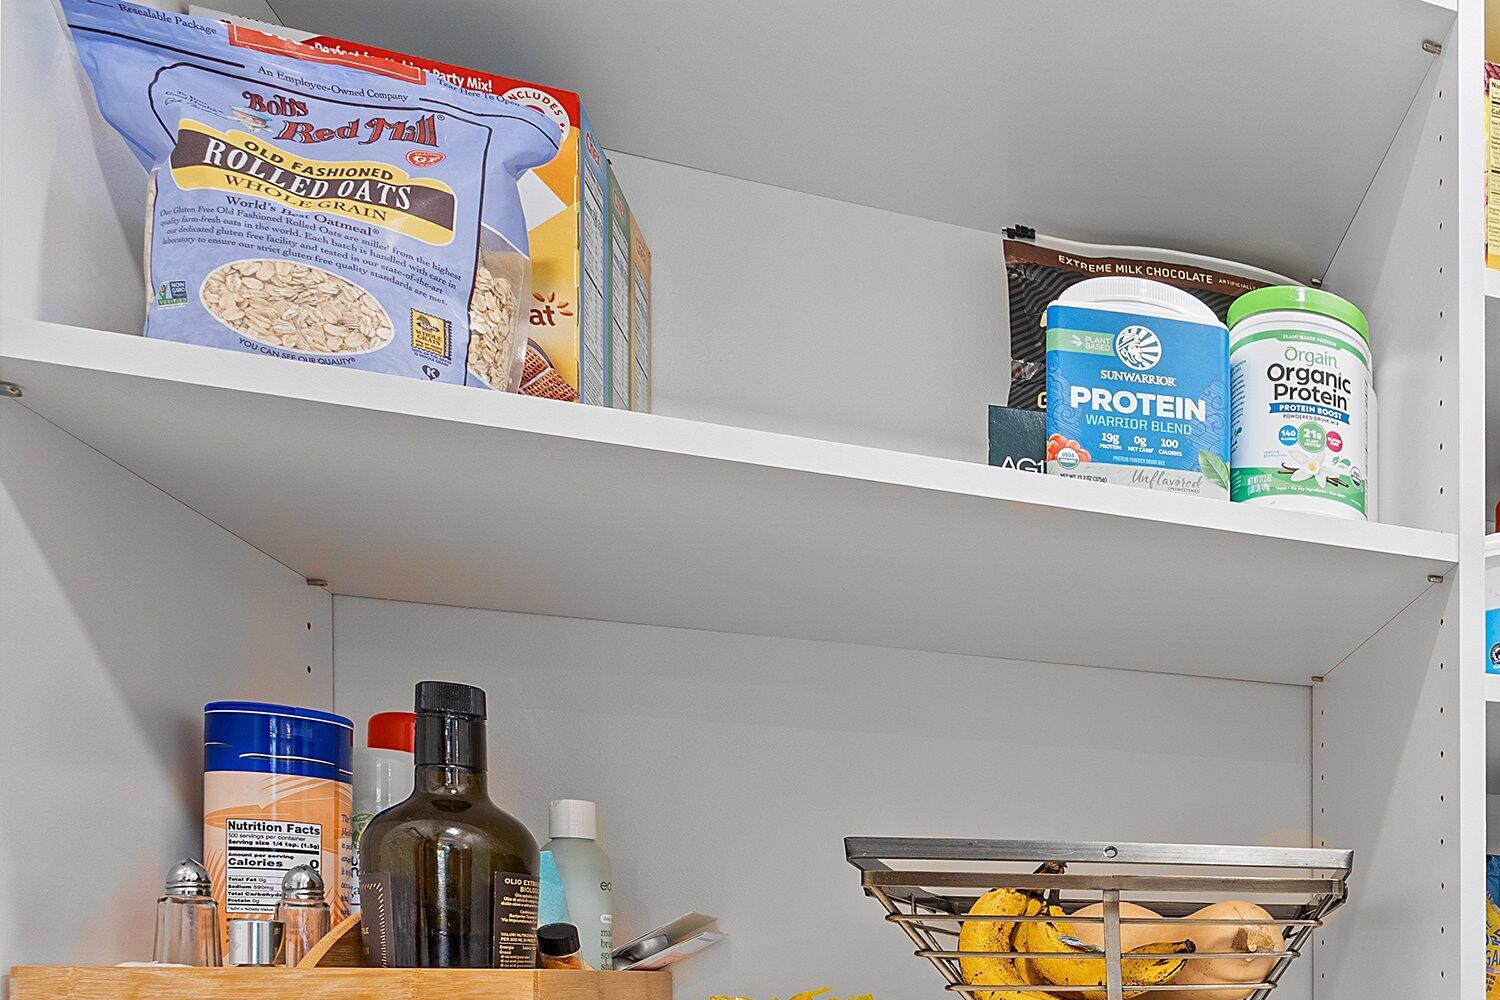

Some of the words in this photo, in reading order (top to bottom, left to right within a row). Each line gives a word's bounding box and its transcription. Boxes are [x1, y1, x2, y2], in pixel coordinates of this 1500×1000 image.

[119, 4, 172, 23] Resealable
[175, 17, 217, 34] Package
[258, 66, 273, 77] An
[277, 71, 364, 97] Employee-Owned
[367, 89, 408, 102] Company
[273, 118, 360, 144] Red
[358, 114, 439, 148] Mill
[203, 137, 329, 199] ROLLED
[338, 179, 411, 210] OATS
[244, 141, 284, 163] OLD
[292, 162, 393, 180] FASHIONED
[224, 174, 312, 210] WHOLE
[318, 200, 387, 221] GRAIN
[226, 196, 276, 212] World's
[237, 210, 282, 224] Fashioned
[216, 227, 244, 237] gluten
[246, 231, 264, 240] free
[266, 235, 298, 247] facility
[300, 243, 317, 251] and
[320, 247, 348, 259] tested
[362, 258, 378, 267] our
[305, 233, 329, 244] Each
[332, 238, 357, 252] batch
[370, 249, 406, 267] handled
[408, 263, 428, 276] with
[208, 238, 236, 246] ensure
[257, 244, 280, 254] strict
[282, 249, 312, 261] gluten
[314, 255, 333, 265] free
[335, 261, 368, 276] quality
[370, 271, 412, 291] standards
[1058, 255, 1112, 273] EXTREME
[1116, 264, 1142, 275] MILK
[1146, 267, 1213, 284] CHOCOLATE
[1086, 336, 1111, 344] PLANT
[1086, 343, 1110, 351] BASED
[1284, 346, 1338, 368] Orgain
[1100, 370, 1176, 387] SUNWARRIOR
[1267, 363, 1351, 394] Organic
[1070, 386, 1206, 422] PROTEIN
[1274, 383, 1348, 411] Protein
[1280, 404, 1316, 413] PROTEIN
[1318, 406, 1342, 418] BOOST
[1086, 414, 1147, 431] WARRIOR
[1152, 421, 1192, 435] BLEND
[1101, 433, 1120, 444] 19g
[1133, 436, 1147, 447] 0g
[1161, 438, 1178, 448] 100
[1132, 470, 1203, 487] Unflavored
[228, 821, 282, 833] Nutrition
[287, 824, 320, 835] Facts
[228, 858, 283, 867] Calories
[309, 860, 319, 869] 0
